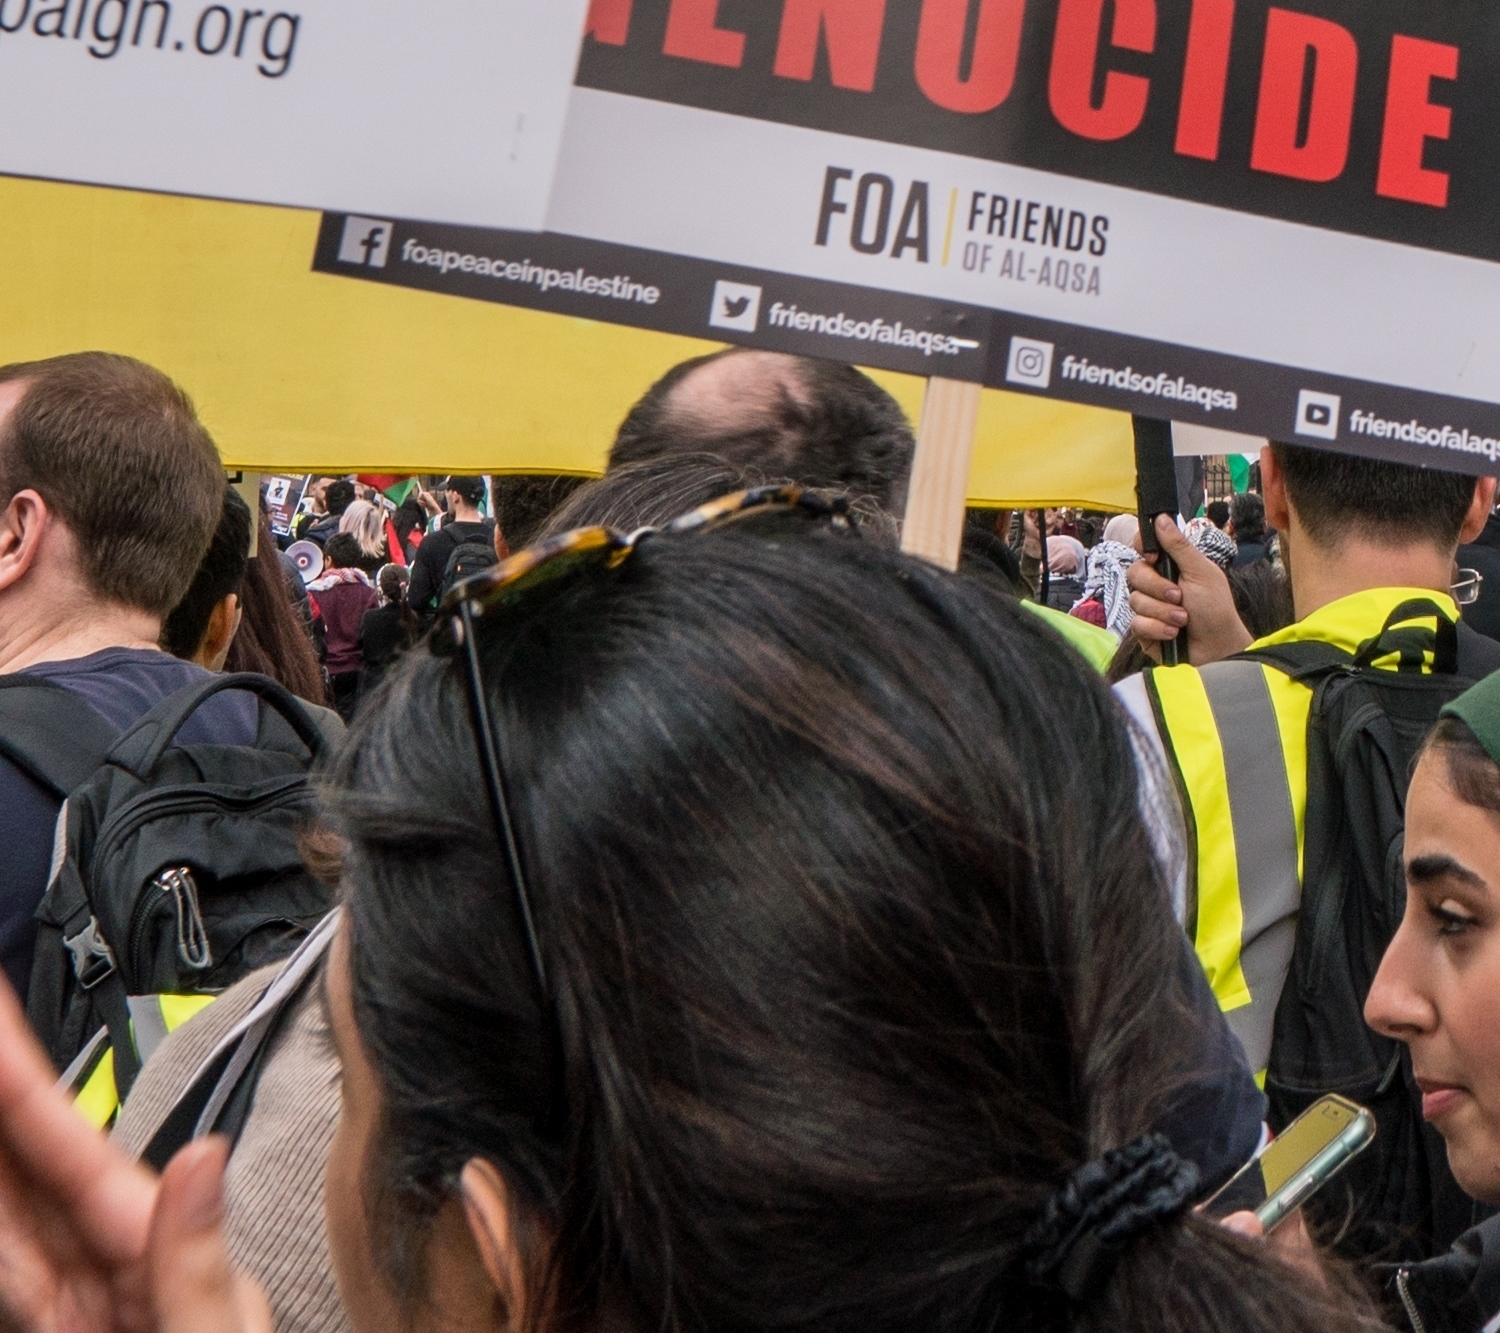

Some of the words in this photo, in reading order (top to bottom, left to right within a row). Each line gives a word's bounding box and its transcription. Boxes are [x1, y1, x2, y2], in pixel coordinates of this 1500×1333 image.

[814, 165, 931, 264] FOA
[966, 190, 1110, 256] FRIENDS
[402, 237, 661, 306] foapeaceinpalestine
[962, 241, 992, 275] OF
[999, 250, 1102, 298] AL-AQSA
[768, 300, 962, 356] friendsofalaqsa
[1061, 355, 1238, 412] friendsofalaqsa
